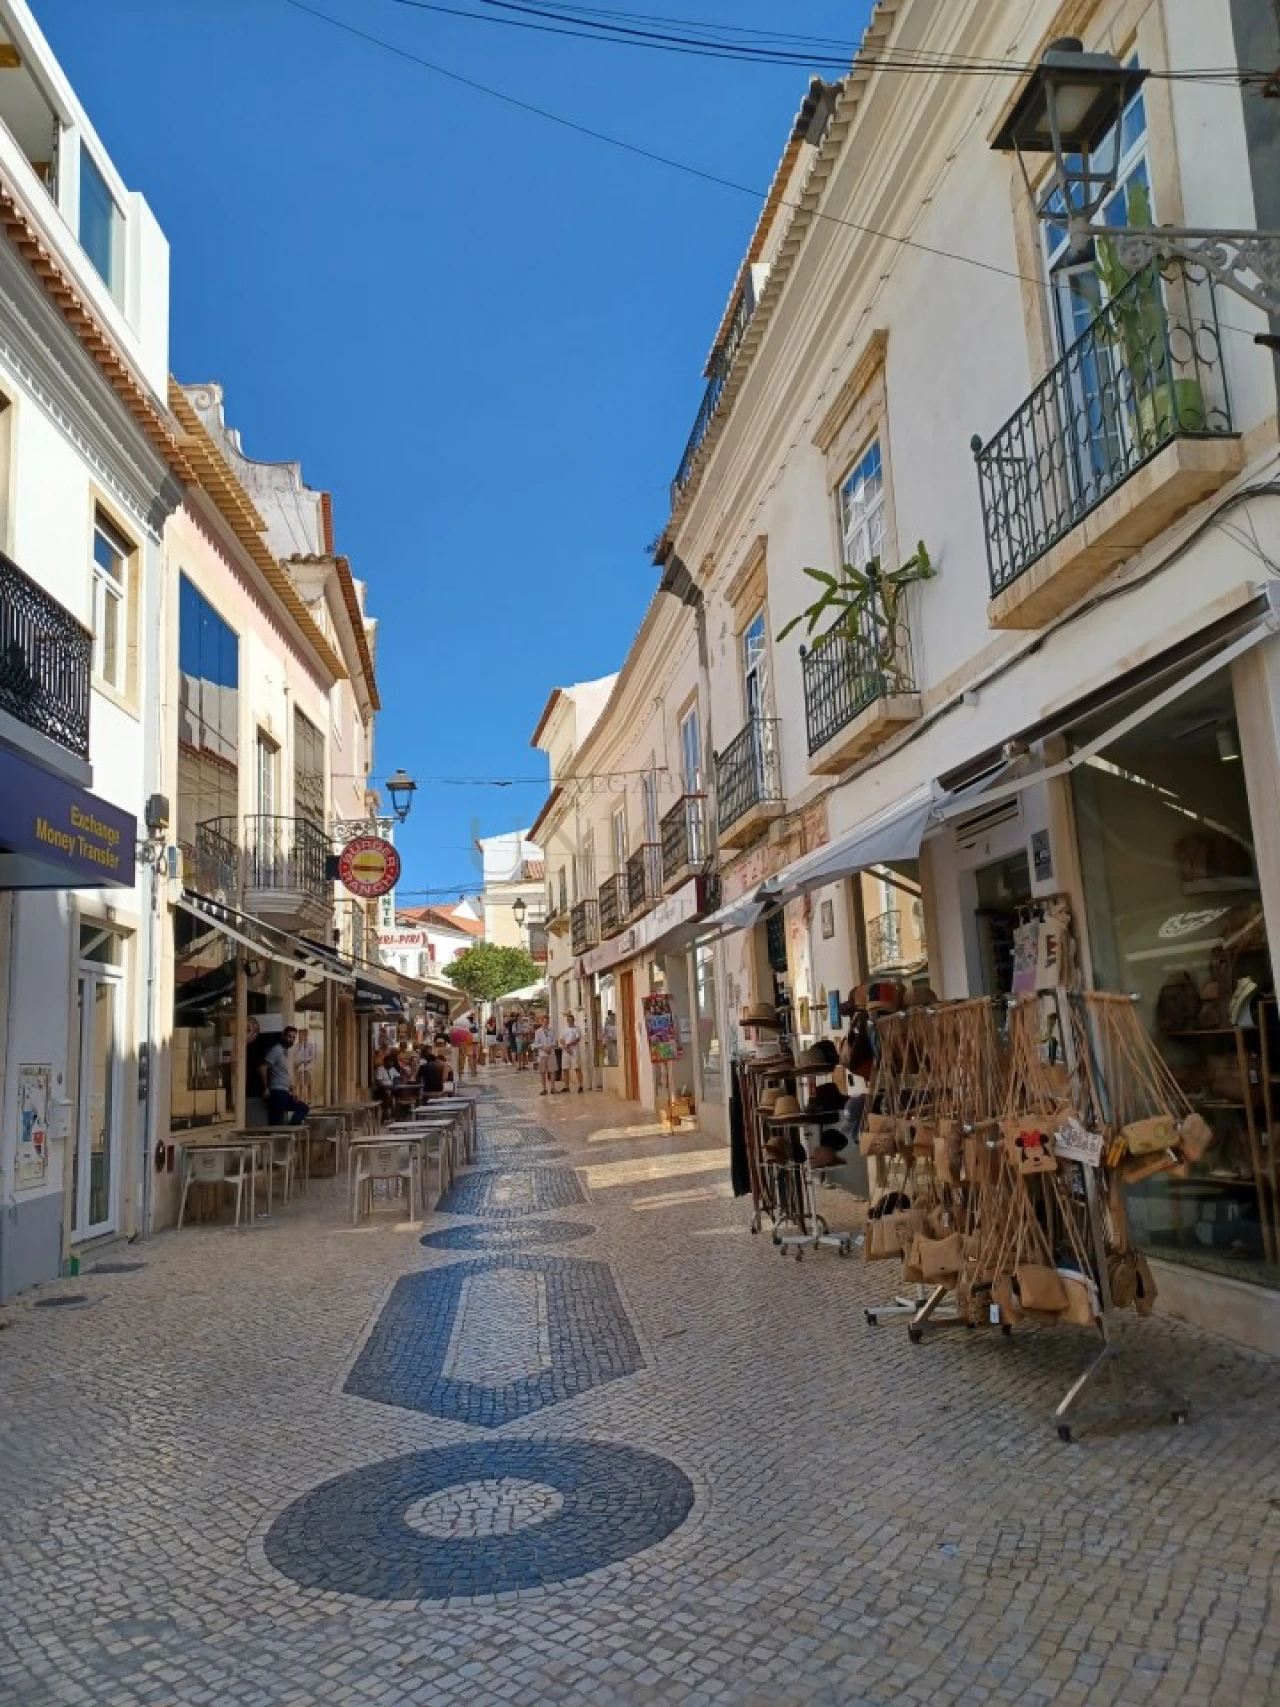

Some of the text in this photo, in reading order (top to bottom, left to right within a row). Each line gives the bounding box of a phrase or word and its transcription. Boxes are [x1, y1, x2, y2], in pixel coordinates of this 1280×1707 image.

[36, 816, 120, 869] Money Transfer
[70, 804, 120, 847] Exchange
[342, 839, 396, 866] BURGER
[342, 871, 394, 894] RANCH
